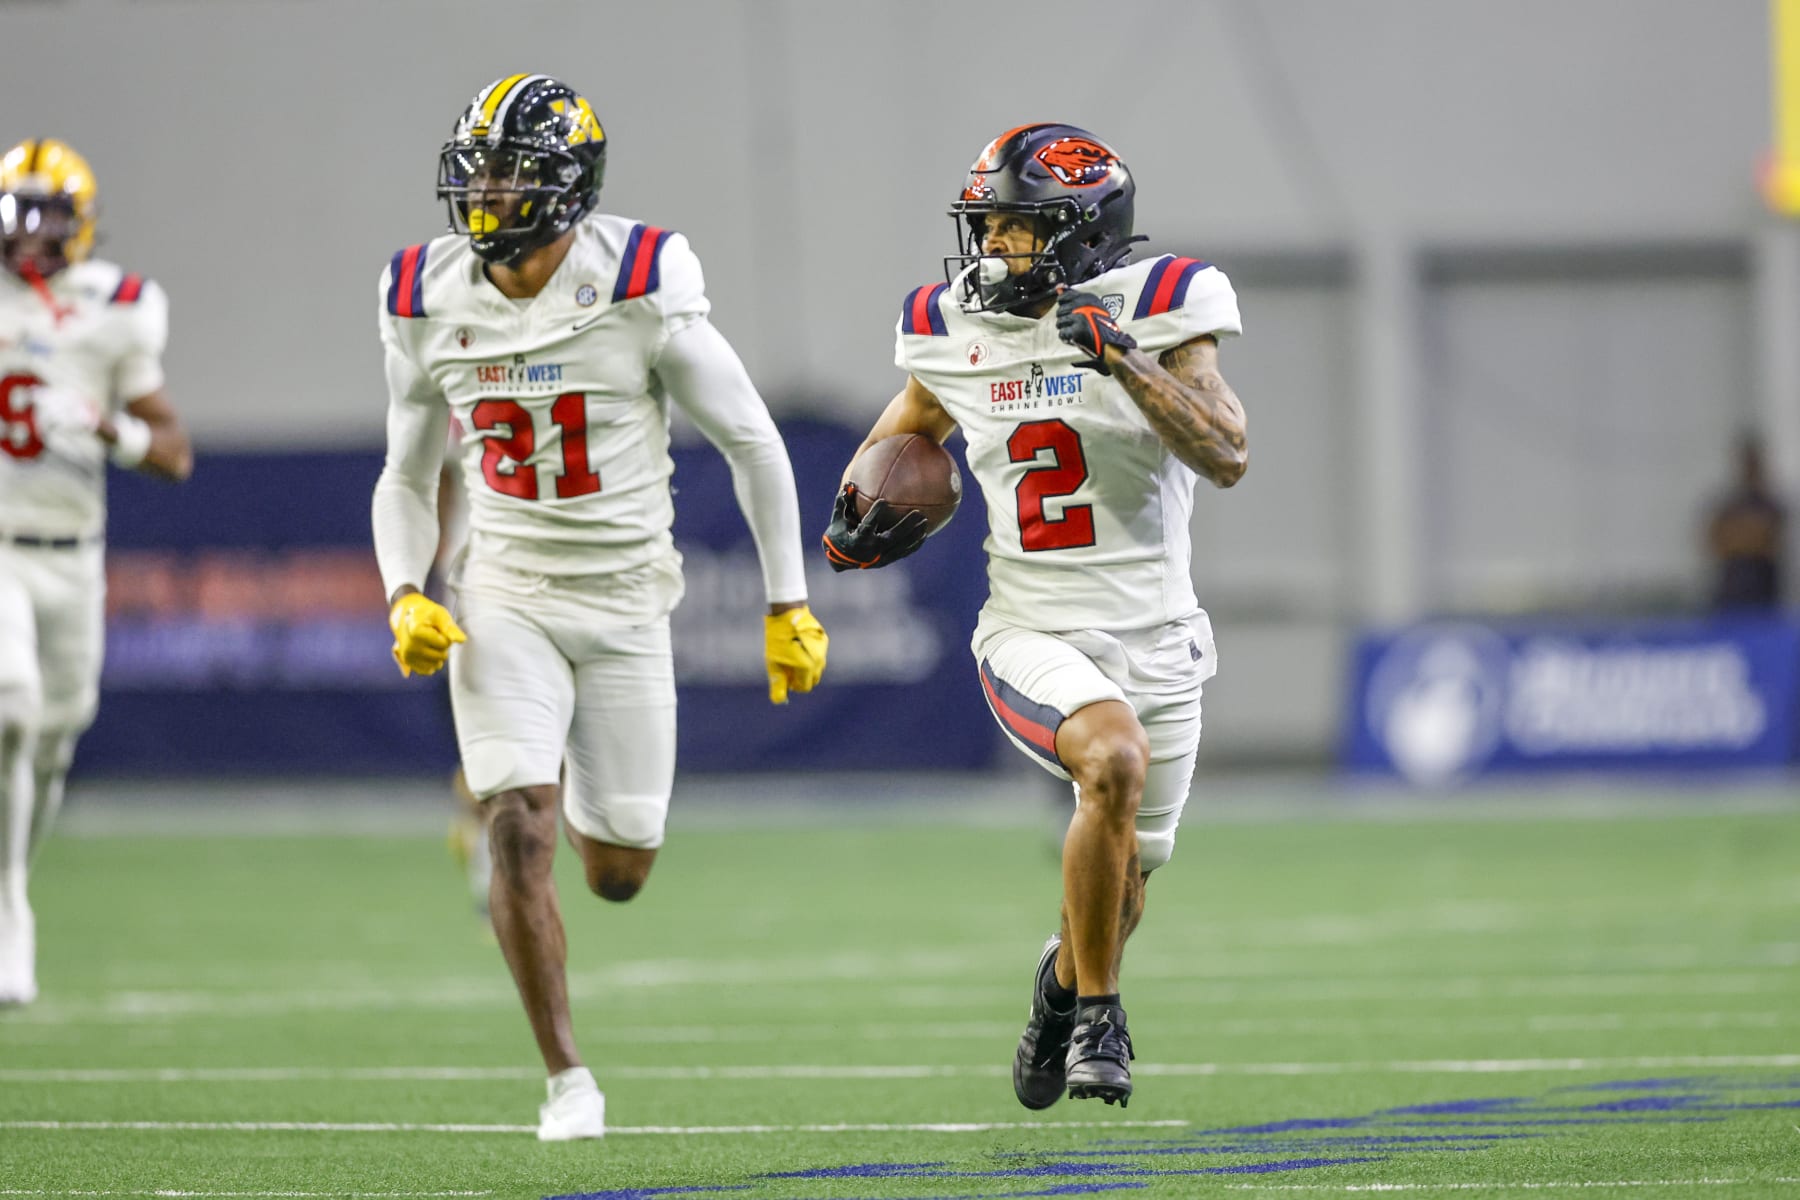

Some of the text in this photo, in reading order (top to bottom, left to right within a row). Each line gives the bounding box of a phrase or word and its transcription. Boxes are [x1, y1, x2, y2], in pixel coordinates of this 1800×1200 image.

[477, 363, 562, 383] EAST WEST
[990, 372, 1083, 403] EAST WEST
[991, 395, 1083, 413] SHRINE BOWL
[471, 392, 602, 500] 21
[1006, 417, 1096, 552] 2
